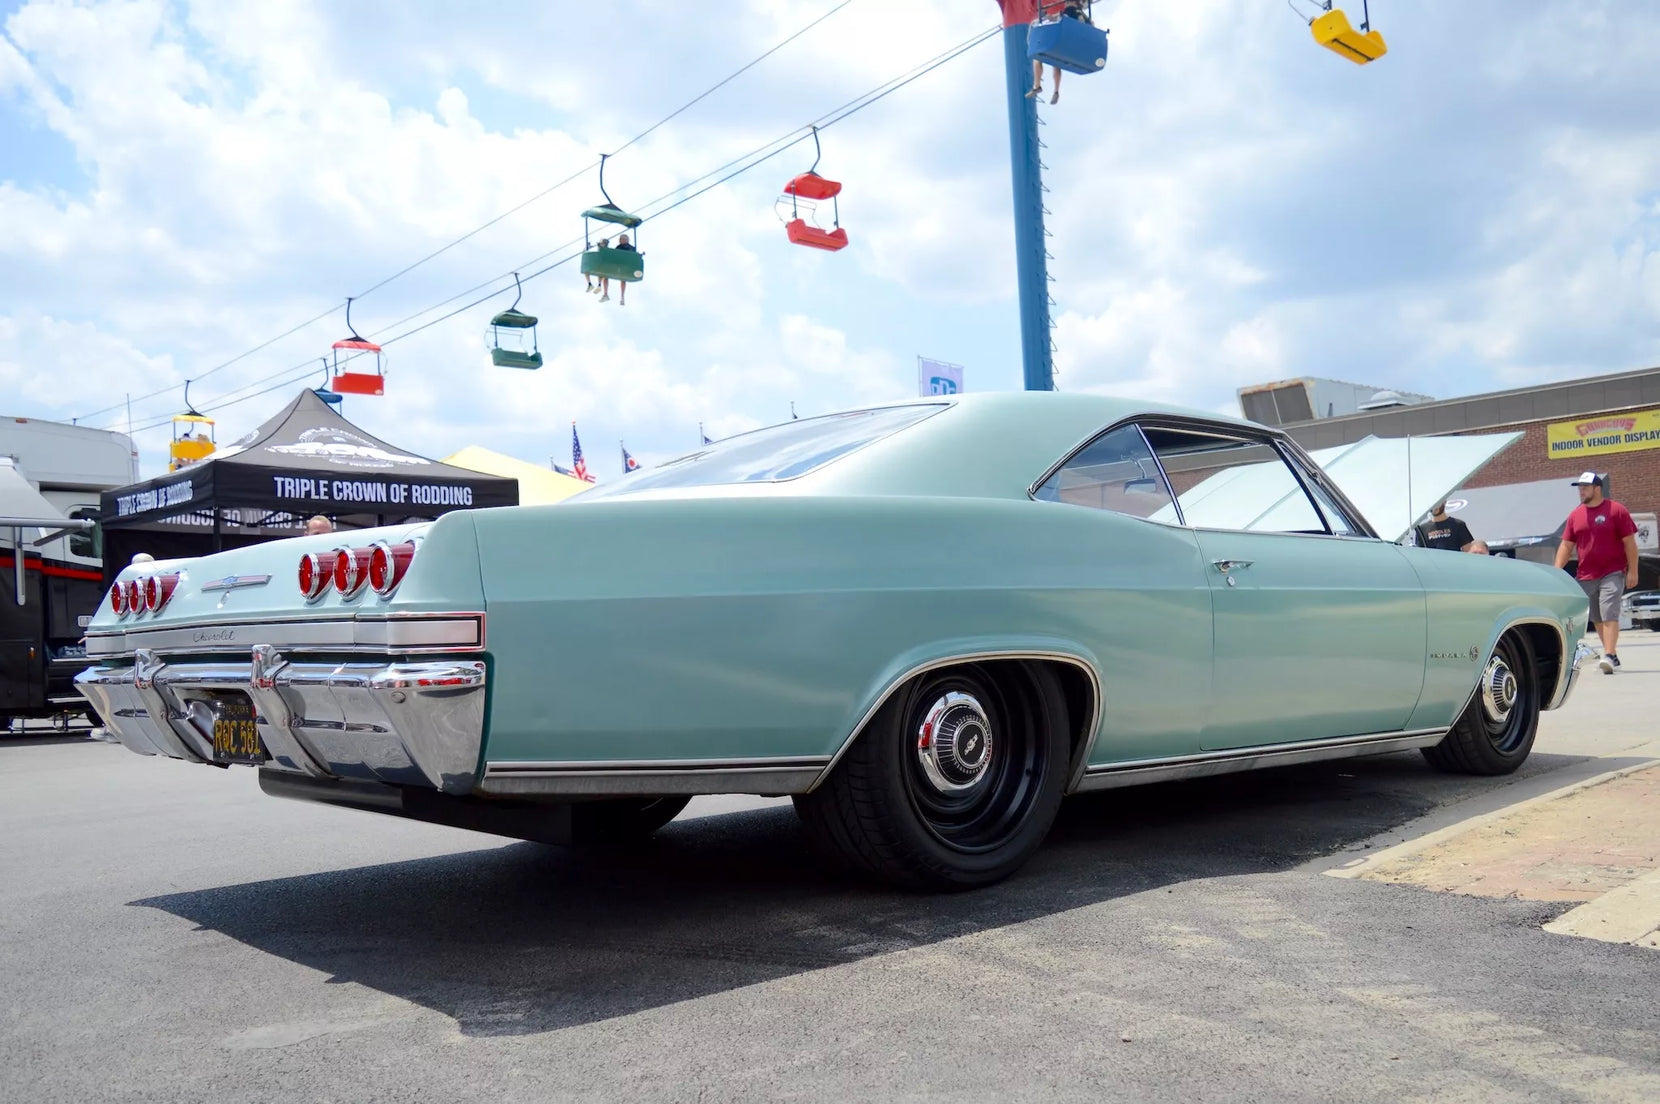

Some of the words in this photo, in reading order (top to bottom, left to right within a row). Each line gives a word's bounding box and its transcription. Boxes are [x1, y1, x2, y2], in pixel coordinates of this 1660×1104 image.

[1552, 440, 1584, 451] INDOOR
[1587, 435, 1621, 447] VENDOR
[1624, 430, 1660, 443] DISPLAY
[274, 477, 329, 500] TRIPLE
[333, 481, 387, 503] CROWN
[390, 484, 408, 504] OF
[412, 485, 473, 506] RODDING
[193, 629, 236, 643] Chevrolet
[240, 720, 261, 755] 581
